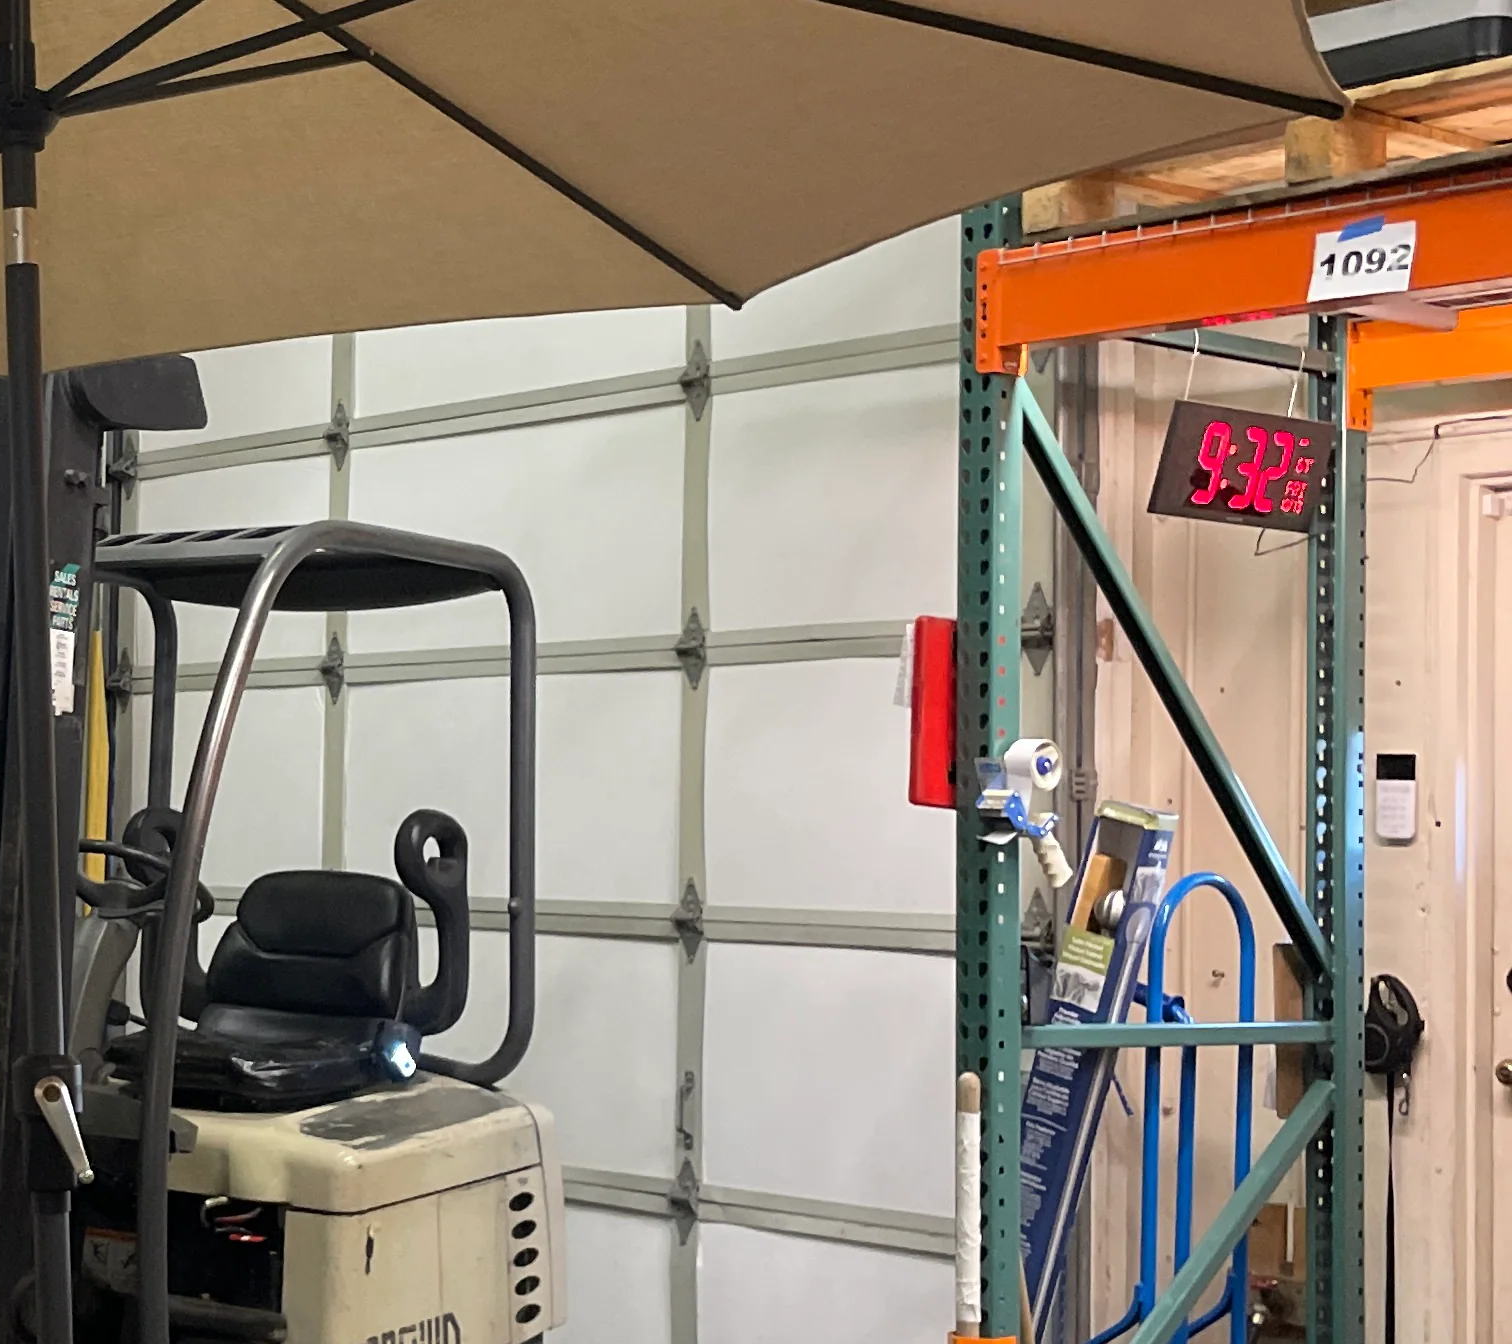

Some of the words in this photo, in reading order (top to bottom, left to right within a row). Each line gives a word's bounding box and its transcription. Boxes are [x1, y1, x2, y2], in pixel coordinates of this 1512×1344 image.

[1319, 243, 1412, 280] 1092
[1190, 420, 1295, 514] 9:32
[54, 570, 77, 587] SALES
